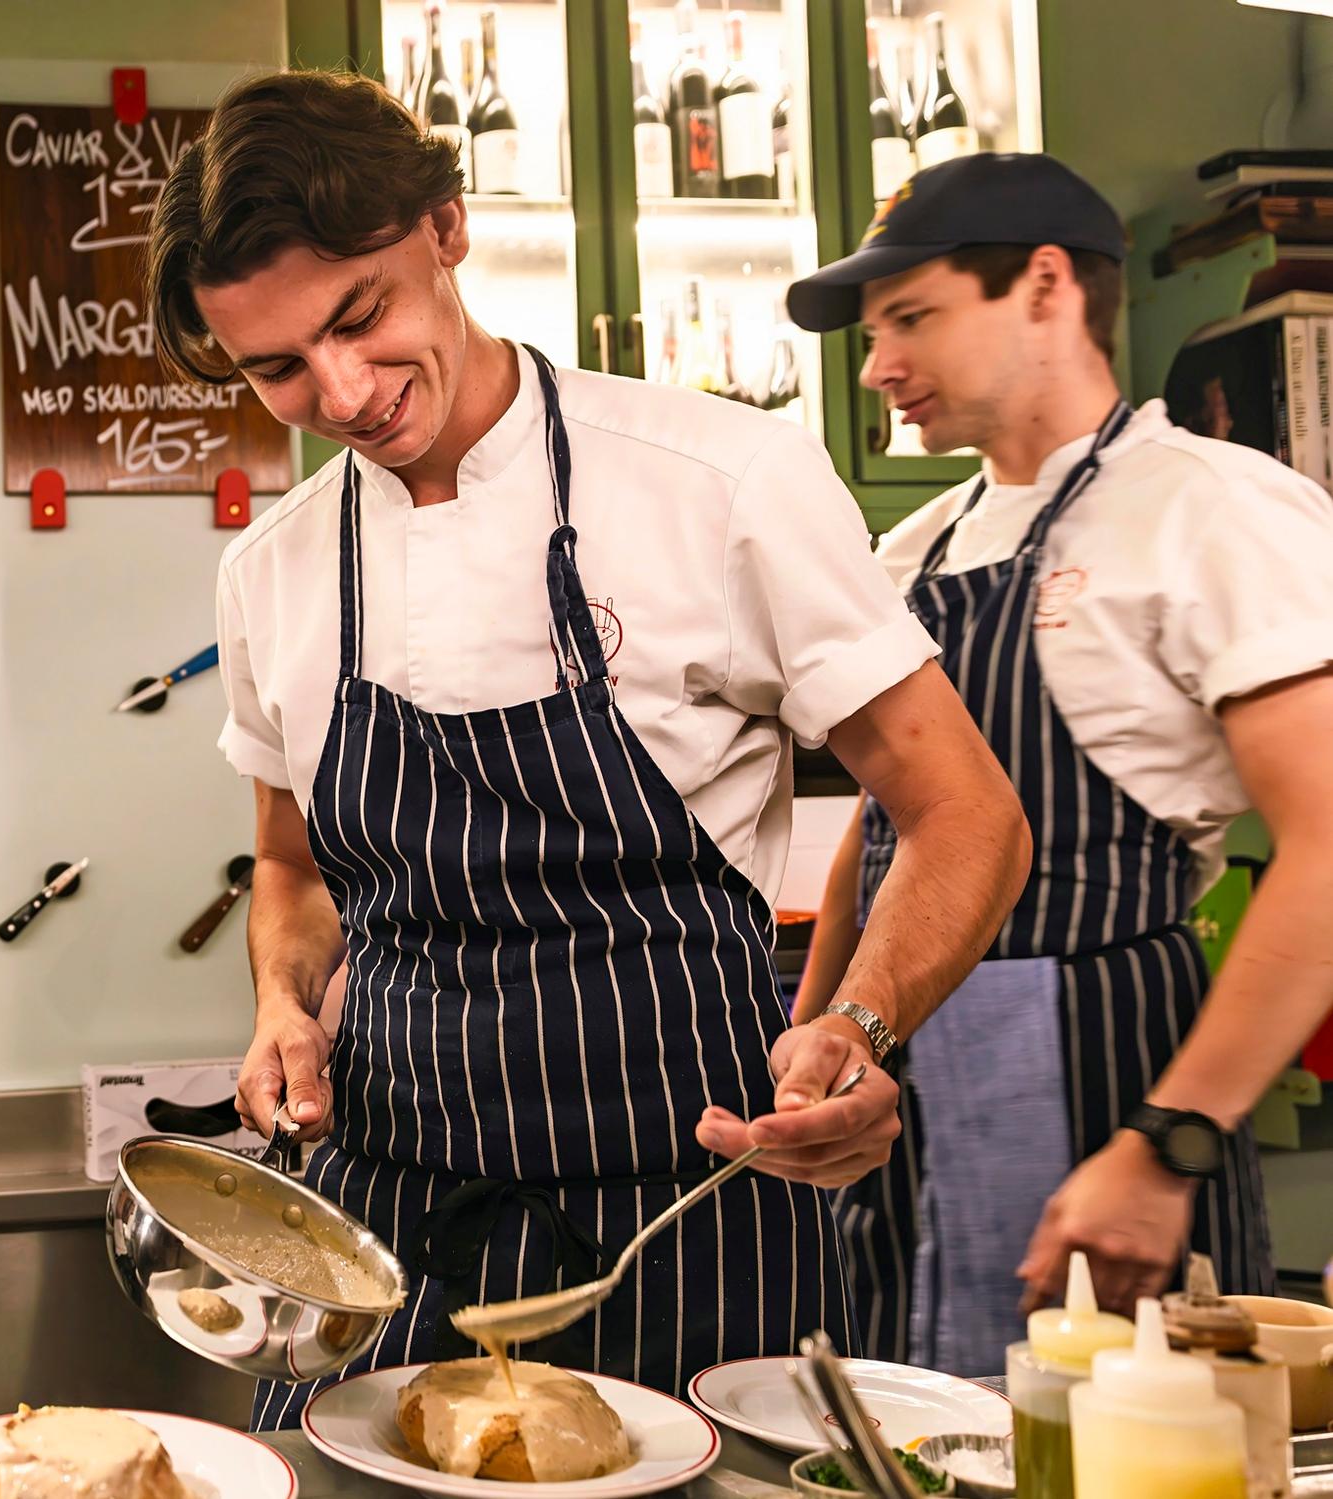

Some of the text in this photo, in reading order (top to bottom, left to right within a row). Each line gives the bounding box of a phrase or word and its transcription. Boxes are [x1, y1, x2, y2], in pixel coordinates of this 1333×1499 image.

[6, 113, 110, 170] CAVIAR
[113, 118, 153, 190] &
[22, 386, 74, 416] MED
